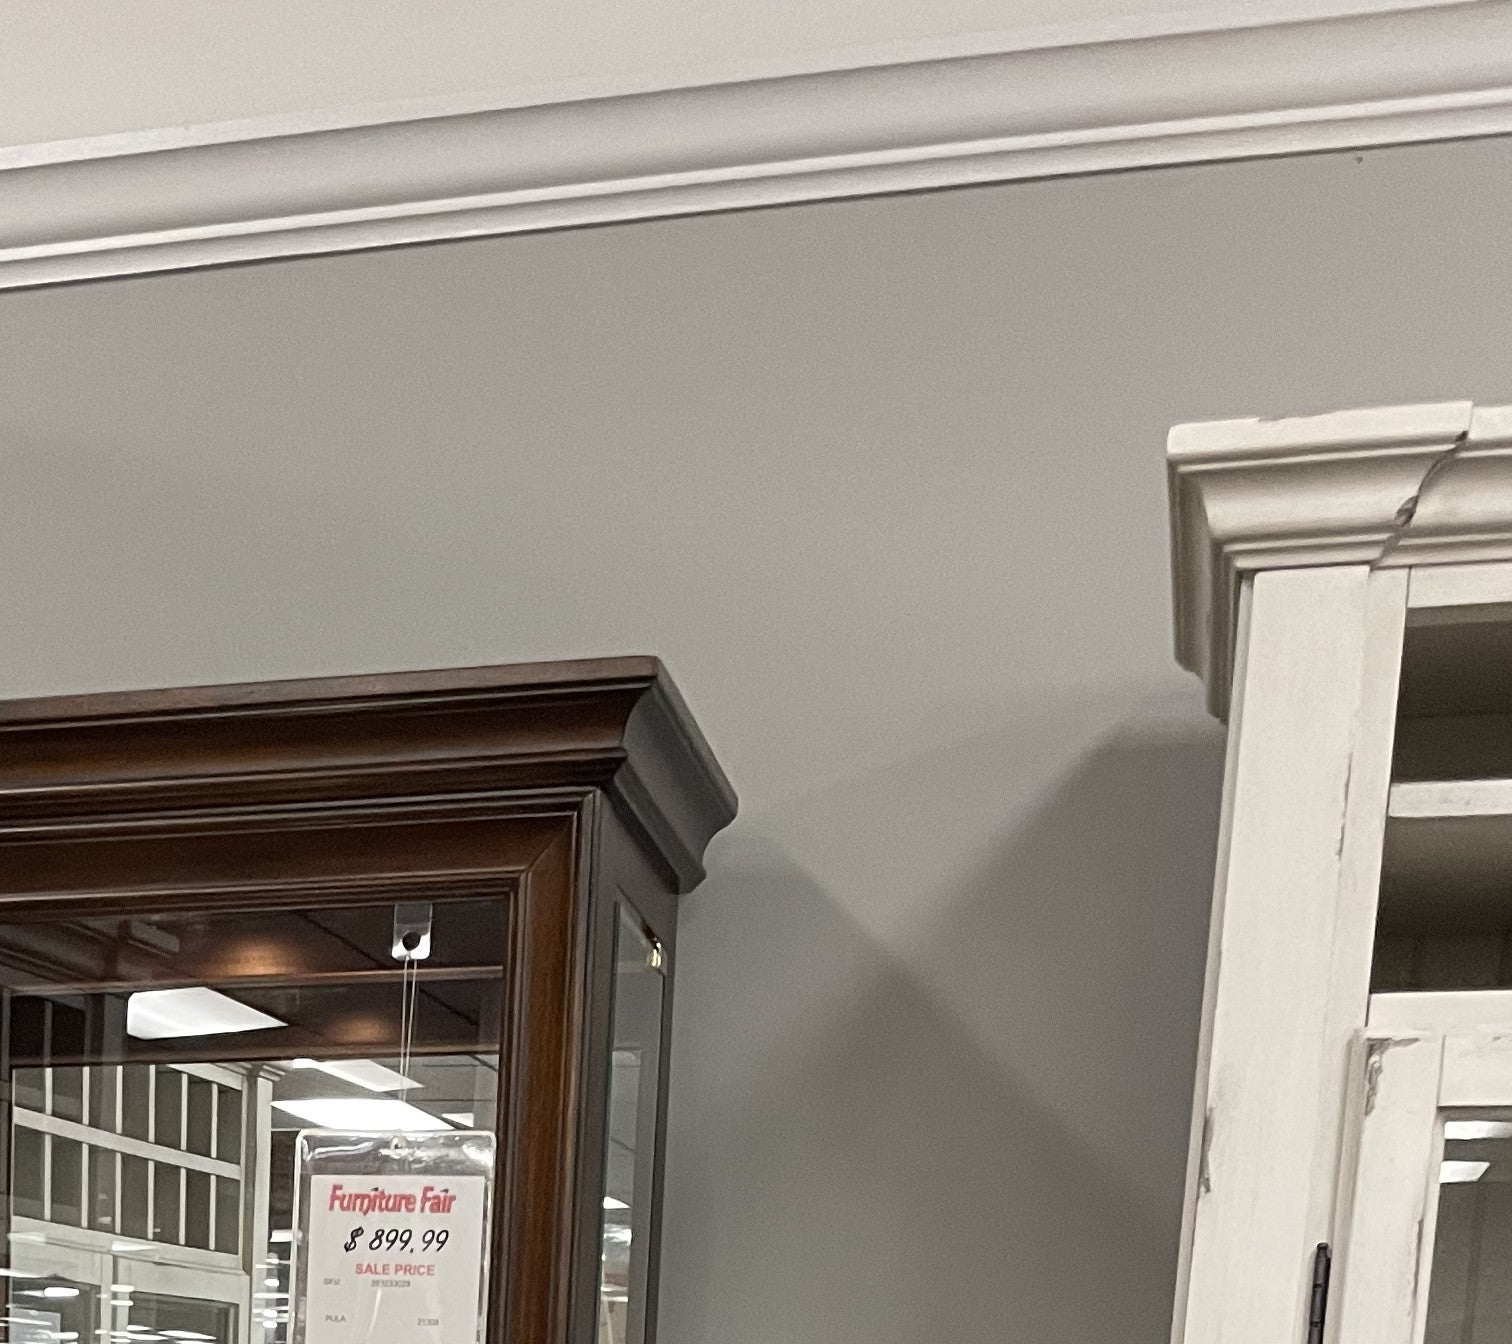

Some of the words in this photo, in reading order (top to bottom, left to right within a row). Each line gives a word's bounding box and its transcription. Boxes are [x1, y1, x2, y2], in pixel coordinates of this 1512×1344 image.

[328, 1184, 416, 1216] Furniture
[420, 1186, 457, 1214] Fair
[355, 1263, 390, 1275] SALE
[394, 1264, 435, 1276] PRICE
